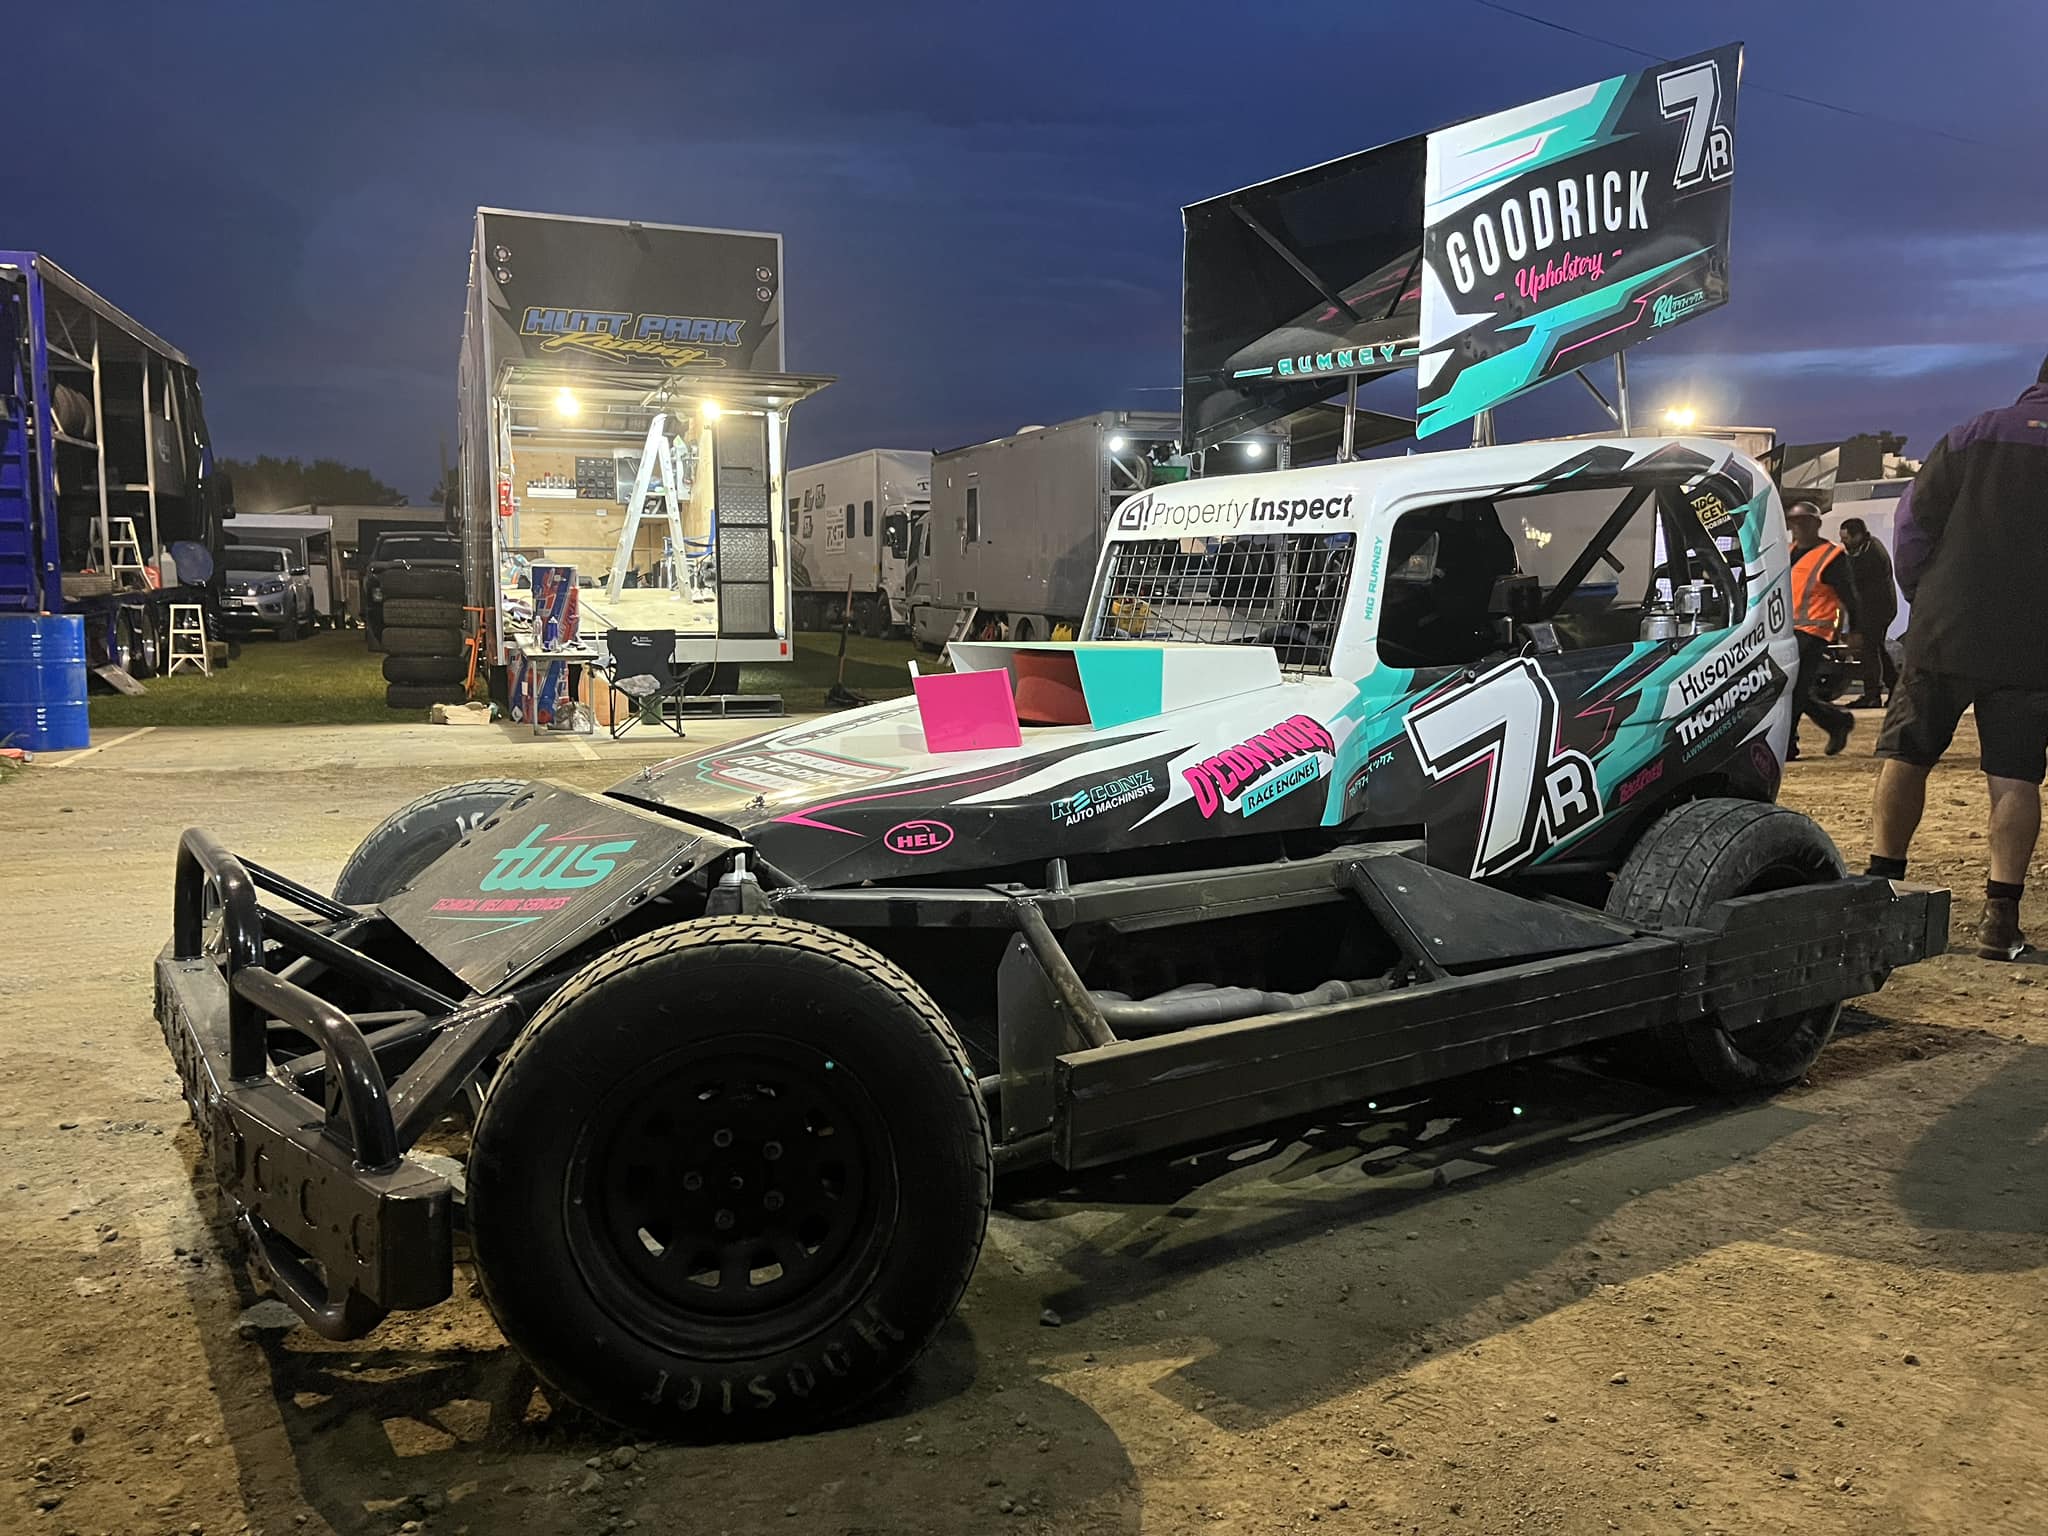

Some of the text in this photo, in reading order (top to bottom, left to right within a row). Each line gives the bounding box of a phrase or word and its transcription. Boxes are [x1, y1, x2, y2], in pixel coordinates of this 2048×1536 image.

[1445, 170, 1650, 294] GOODRICK
[1514, 250, 1605, 303] Upholstery
[521, 306, 744, 346] HUTT PARK
[542, 331, 712, 367] Racing
[1277, 343, 1396, 375] RUMNEY
[1152, 494, 1354, 531] Property Inspect
[1367, 536, 1384, 594] RUMNEY
[1678, 621, 1766, 706] Husqvarna
[1675, 658, 1773, 747] THOMPSON
[1050, 770, 1153, 820] RECONZ
[1065, 783, 1156, 827] AUTO MACHINISTS
[1247, 763, 1315, 810] RACE ENGINES
[897, 831, 943, 848] HEL
